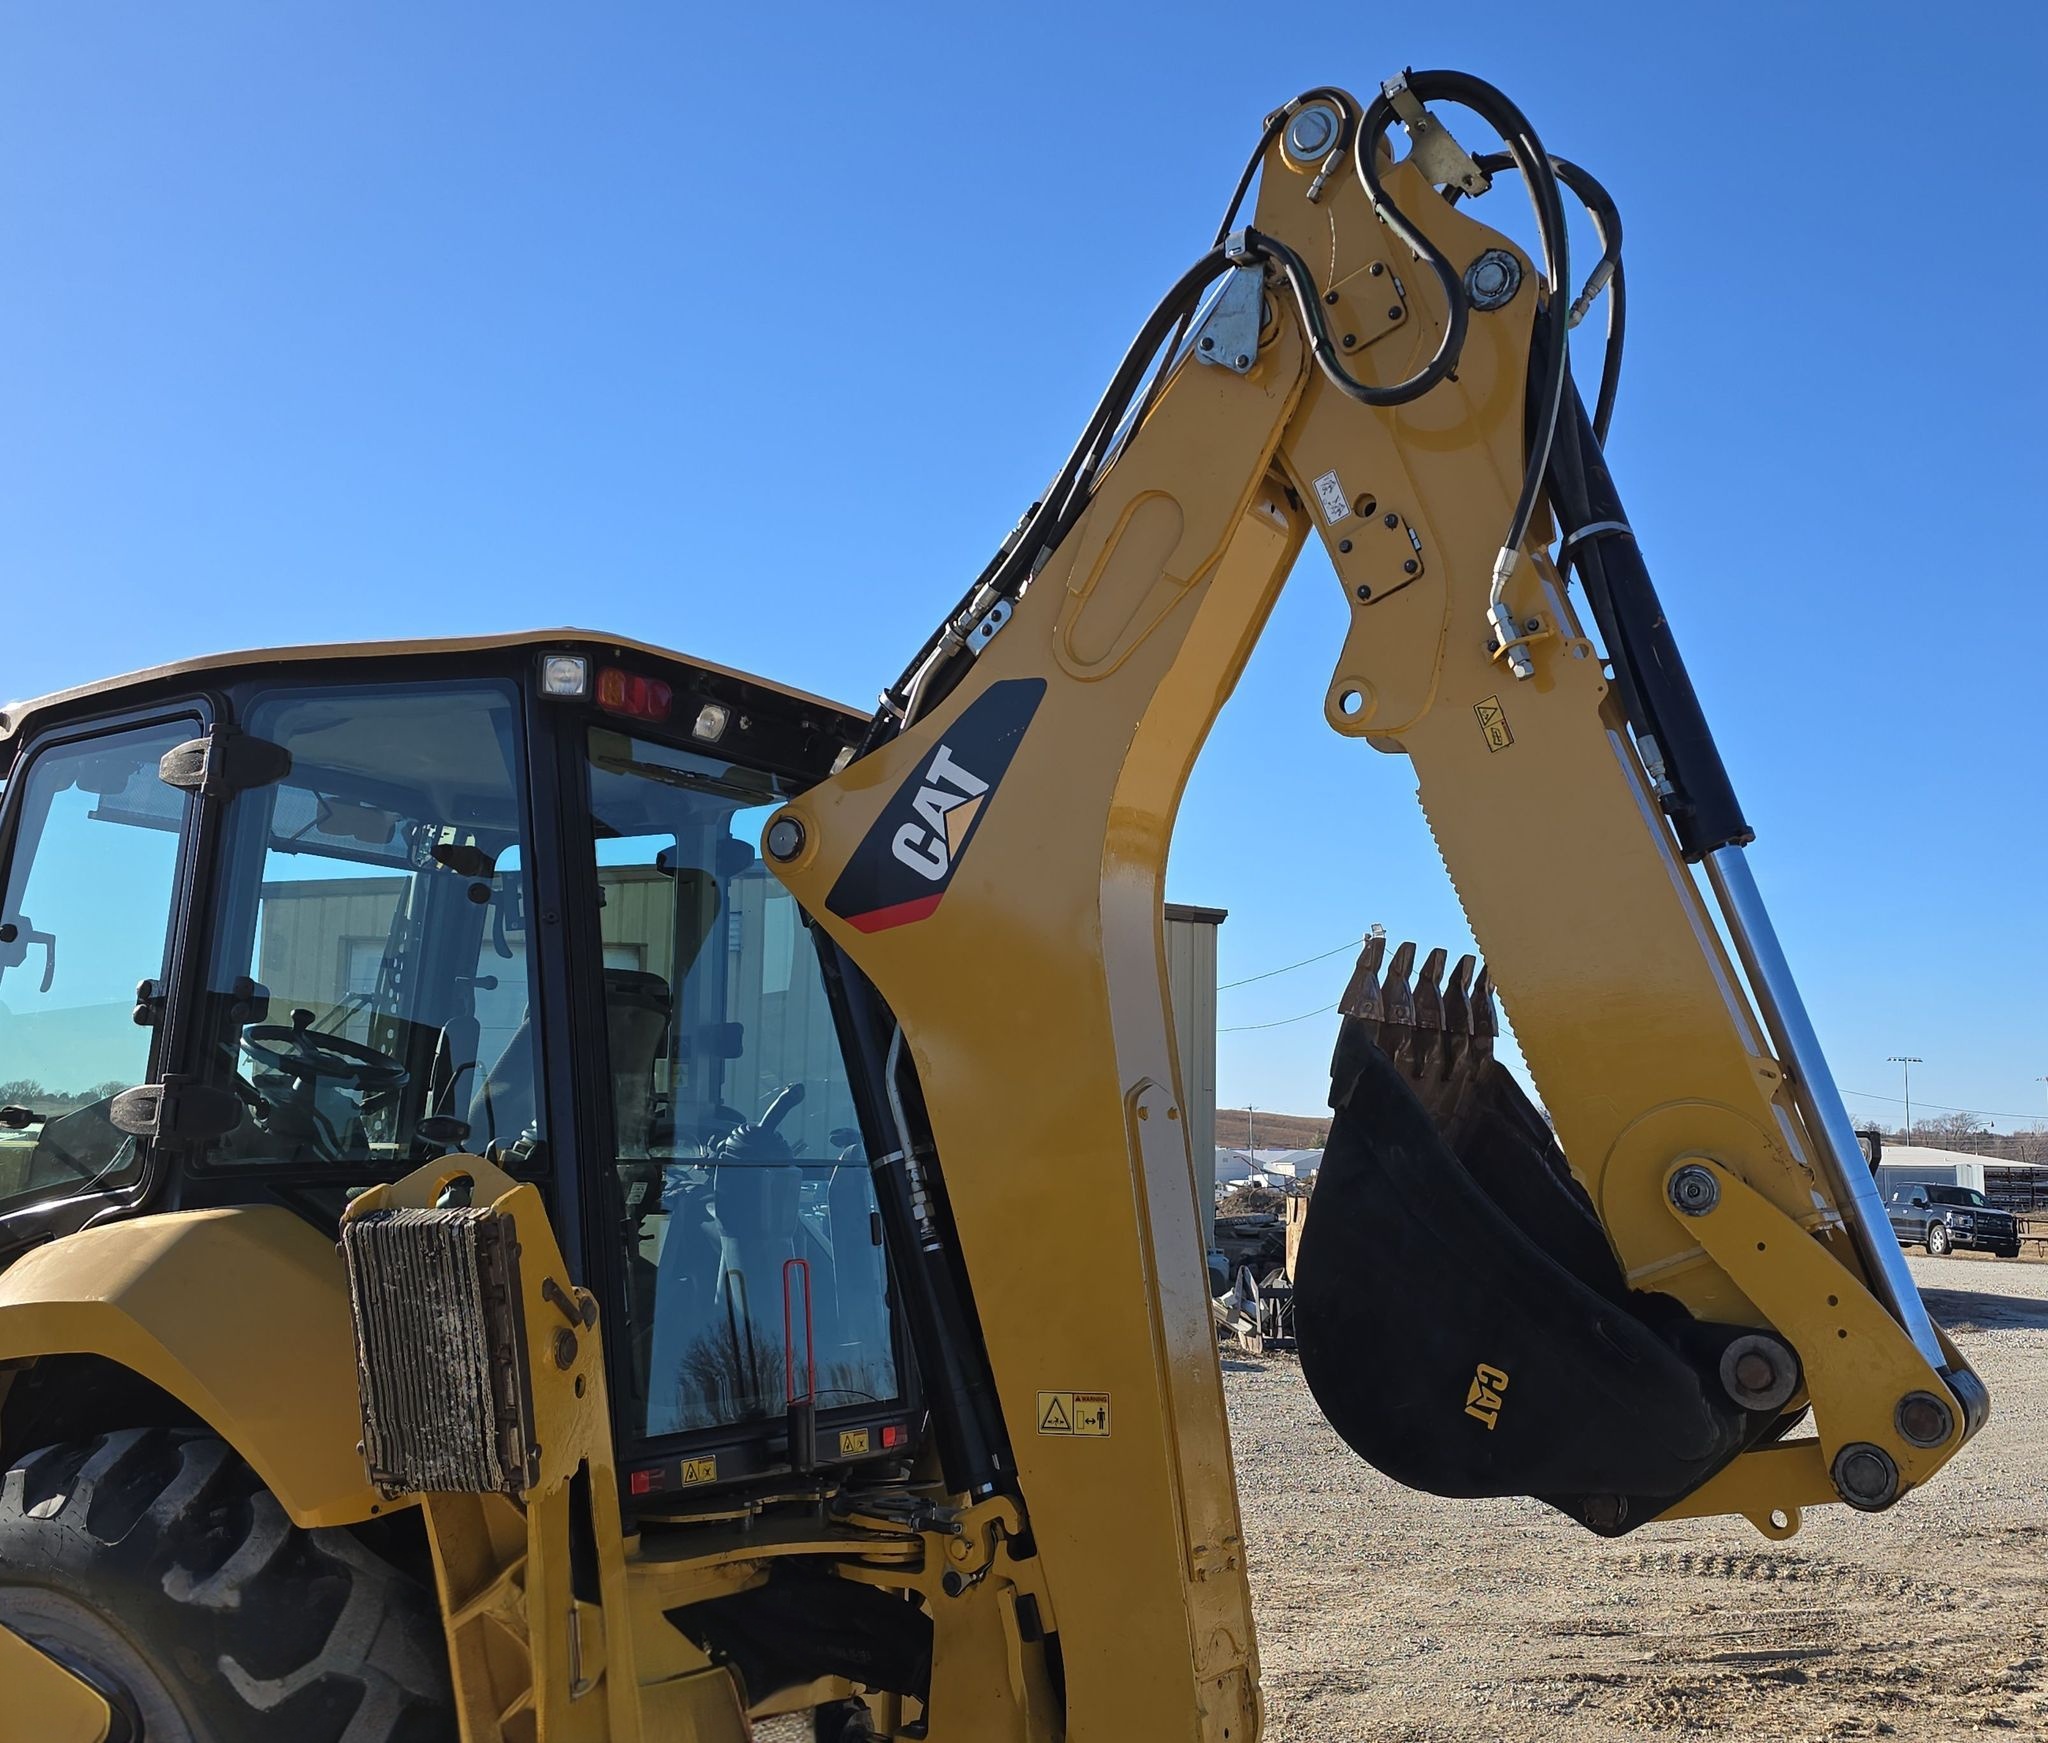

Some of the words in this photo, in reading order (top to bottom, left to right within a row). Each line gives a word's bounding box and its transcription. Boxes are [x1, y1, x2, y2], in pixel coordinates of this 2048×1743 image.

[891, 743, 990, 881] CAT
[1081, 1395, 1107, 1403] WARNING
[1464, 1363, 1509, 1430] CAT
